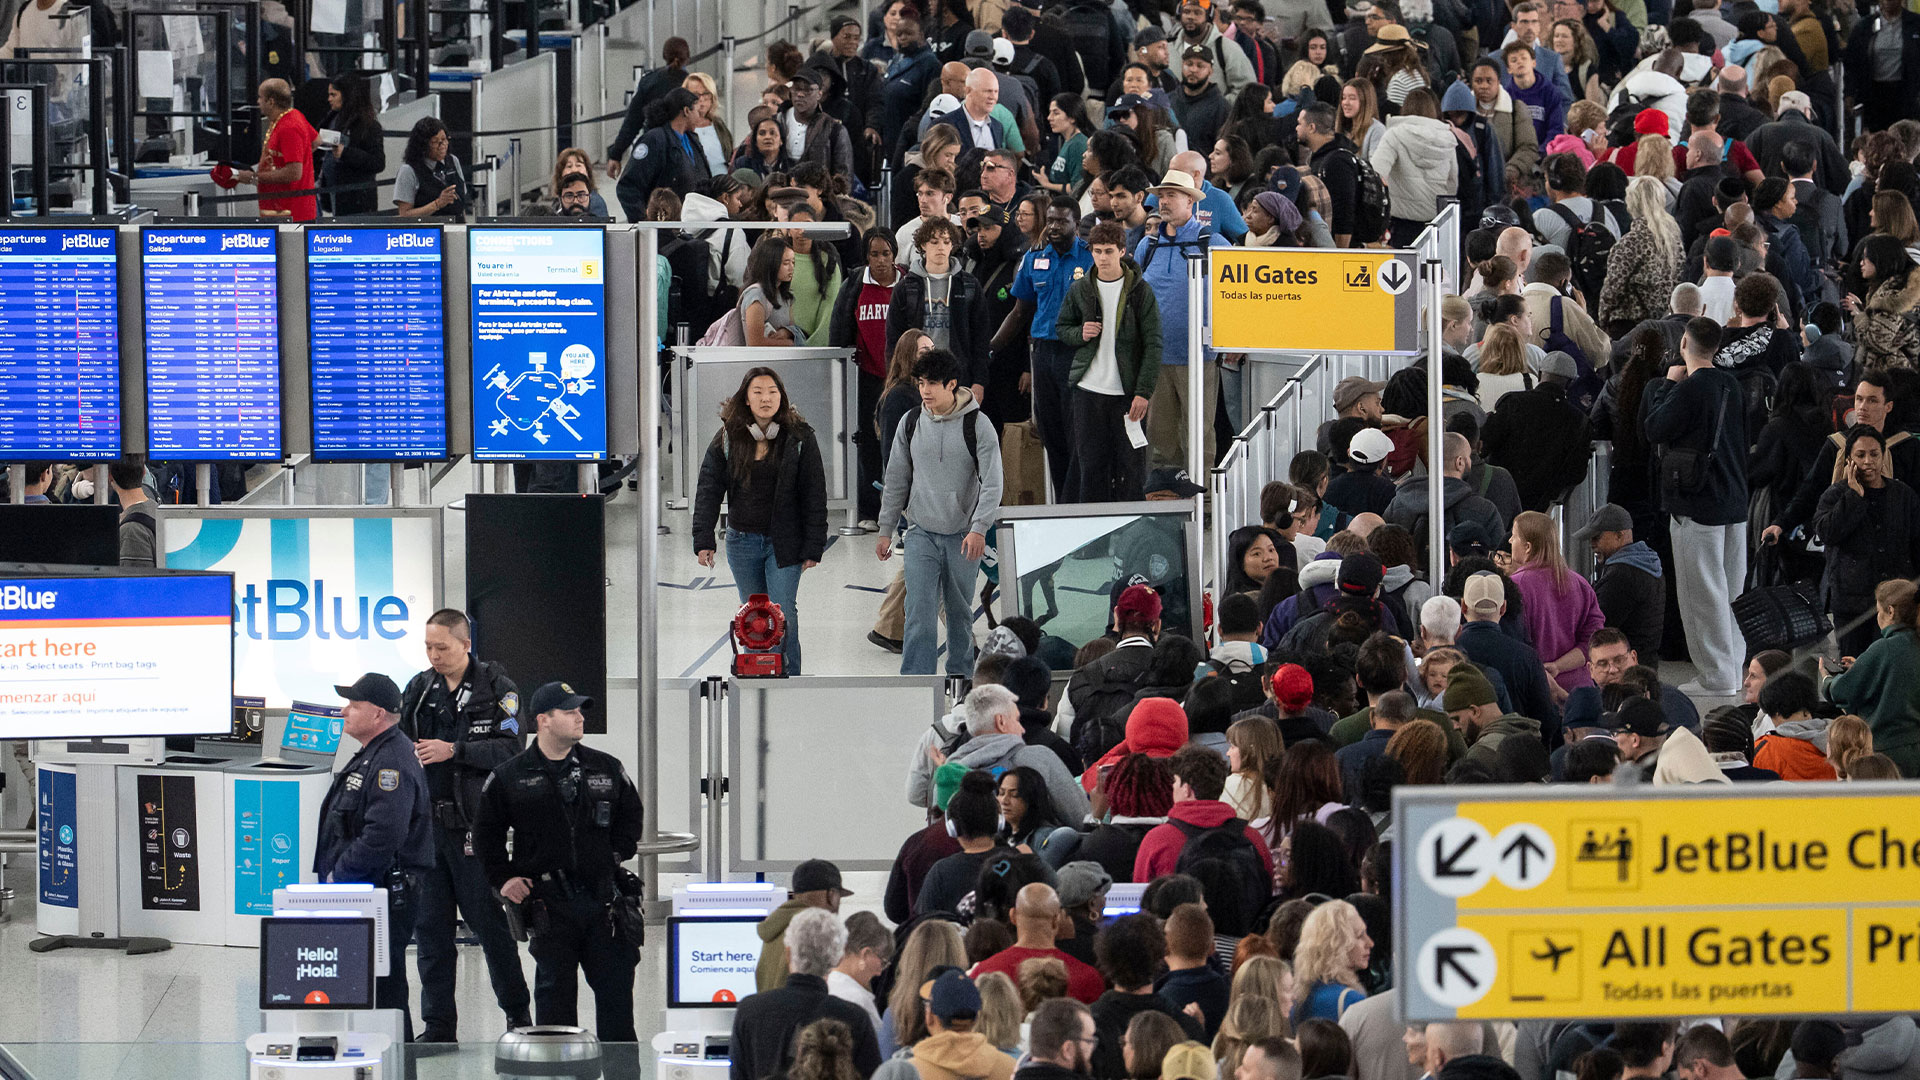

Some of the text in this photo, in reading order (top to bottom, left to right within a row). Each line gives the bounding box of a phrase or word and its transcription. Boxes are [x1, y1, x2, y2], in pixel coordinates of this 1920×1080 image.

[74, 72, 83, 86] 4
[62, 234, 110, 251] jetBlue
[148, 234, 270, 251] Departures jetBlue
[313, 234, 434, 250] Arrivals jetBlue
[476, 235, 553, 246] CONNECTIONS
[586, 265, 592, 274] 5
[1220, 264, 1318, 285] All Gates
[517, 298, 547, 306] proceed
[556, 298, 570, 307] bag
[1220, 291, 1302, 302] Todas las puertas
[235, 580, 409, 640] tBlue
[45, 638, 96, 656] here
[91, 661, 114, 669] Print
[116, 661, 134, 670] bag
[136, 661, 157, 669] tags
[1652, 830, 1828, 874] JetBlue
[297, 947, 338, 961] Hello!
[1600, 926, 1832, 969] All Gates
[692, 951, 756, 962] Start here.
[297, 964, 337, 980] ¡Hola!
[1601, 979, 1793, 1003] Todas las puertas
